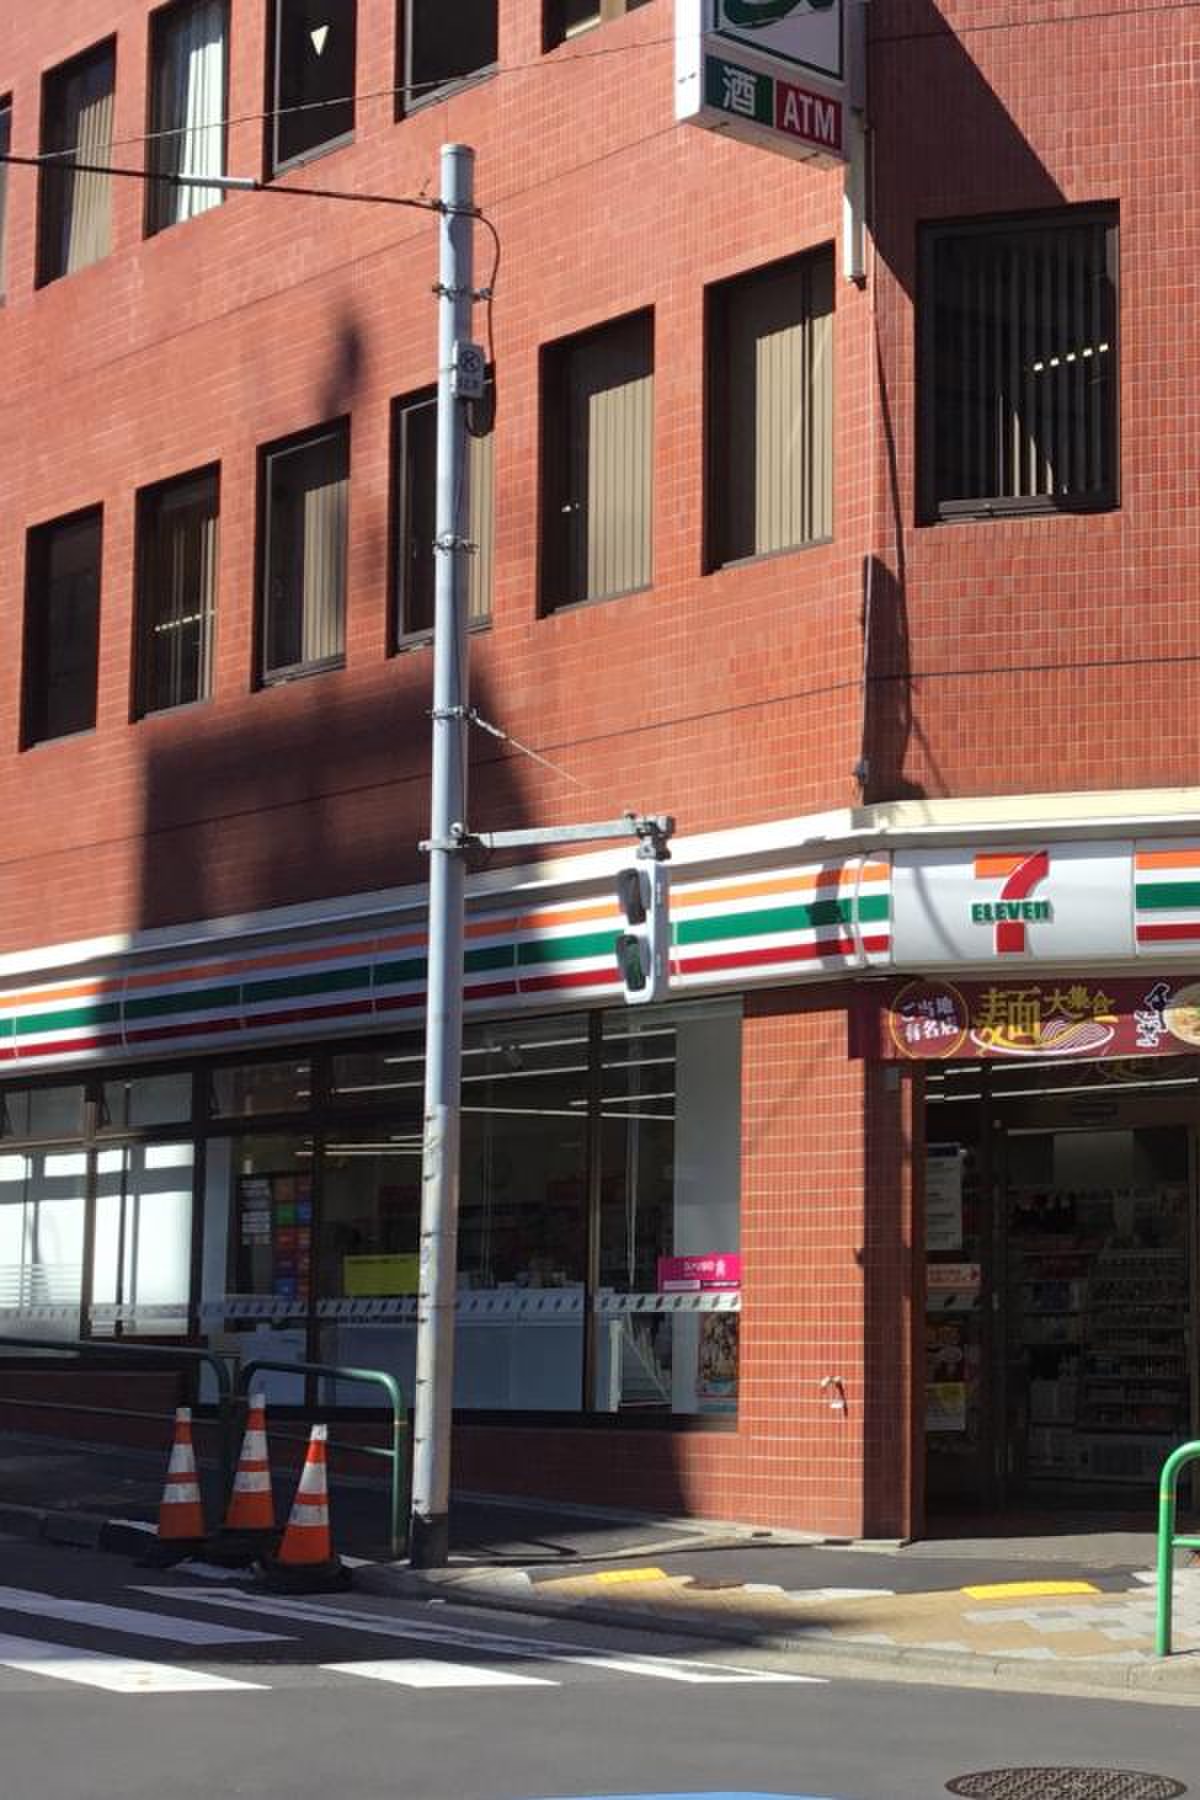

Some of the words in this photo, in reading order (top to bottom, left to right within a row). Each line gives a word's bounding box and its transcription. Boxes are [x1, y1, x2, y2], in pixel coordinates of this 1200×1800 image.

[722, 66, 758, 117] 酒
[783, 90, 836, 146] ATM
[973, 849, 1050, 953] 7
